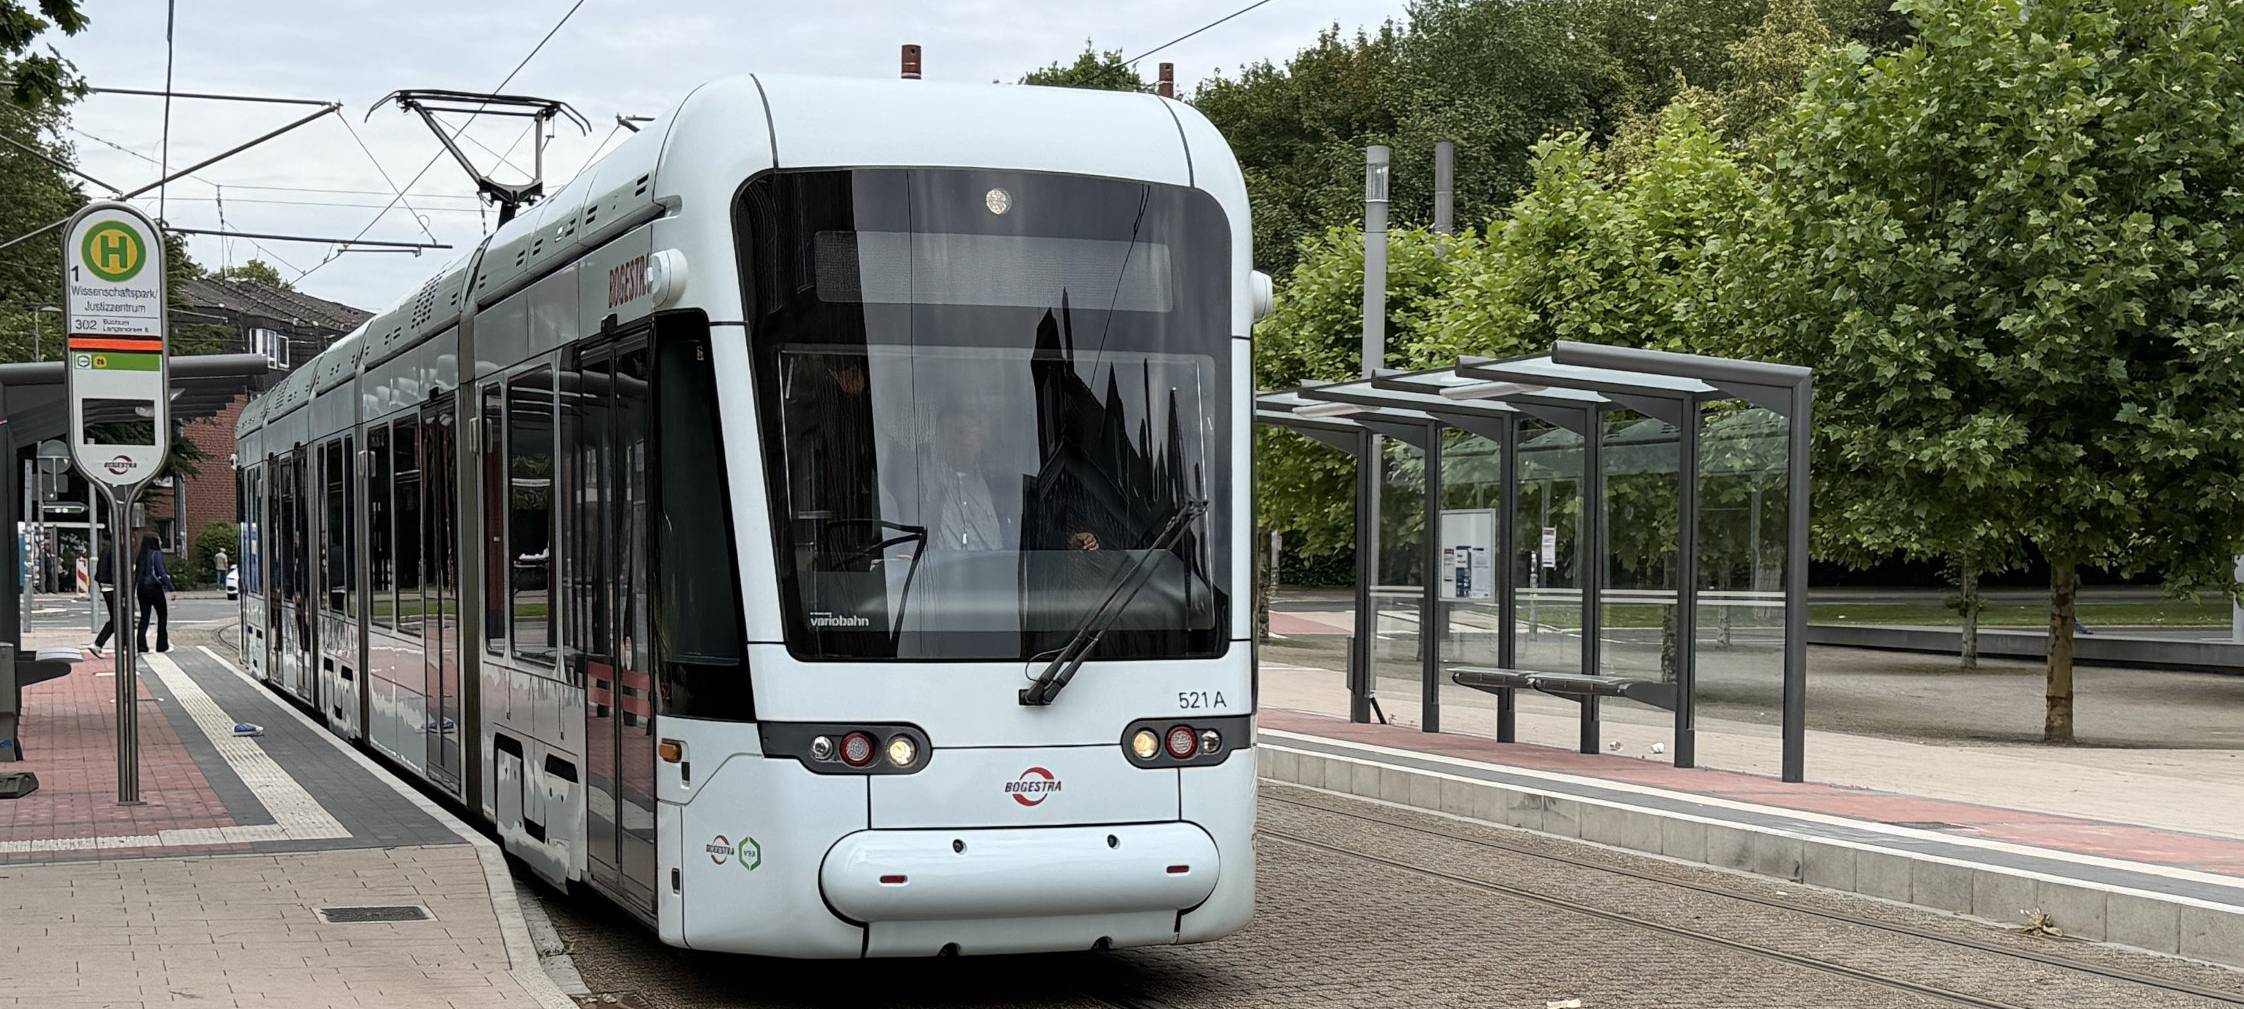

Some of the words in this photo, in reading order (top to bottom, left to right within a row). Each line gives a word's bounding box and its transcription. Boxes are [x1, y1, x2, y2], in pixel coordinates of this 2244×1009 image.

[100, 235, 128, 268] H
[71, 265, 79, 282] 1
[71, 285, 158, 300] Wissenschaftspark/
[84, 301, 146, 313] Justizzentrum
[75, 319, 97, 330] 302
[810, 615, 869, 626] variobahn
[1179, 691, 1209, 709] 521
[1213, 691, 1228, 708] A
[1004, 780, 1063, 793] BOGESTRA
